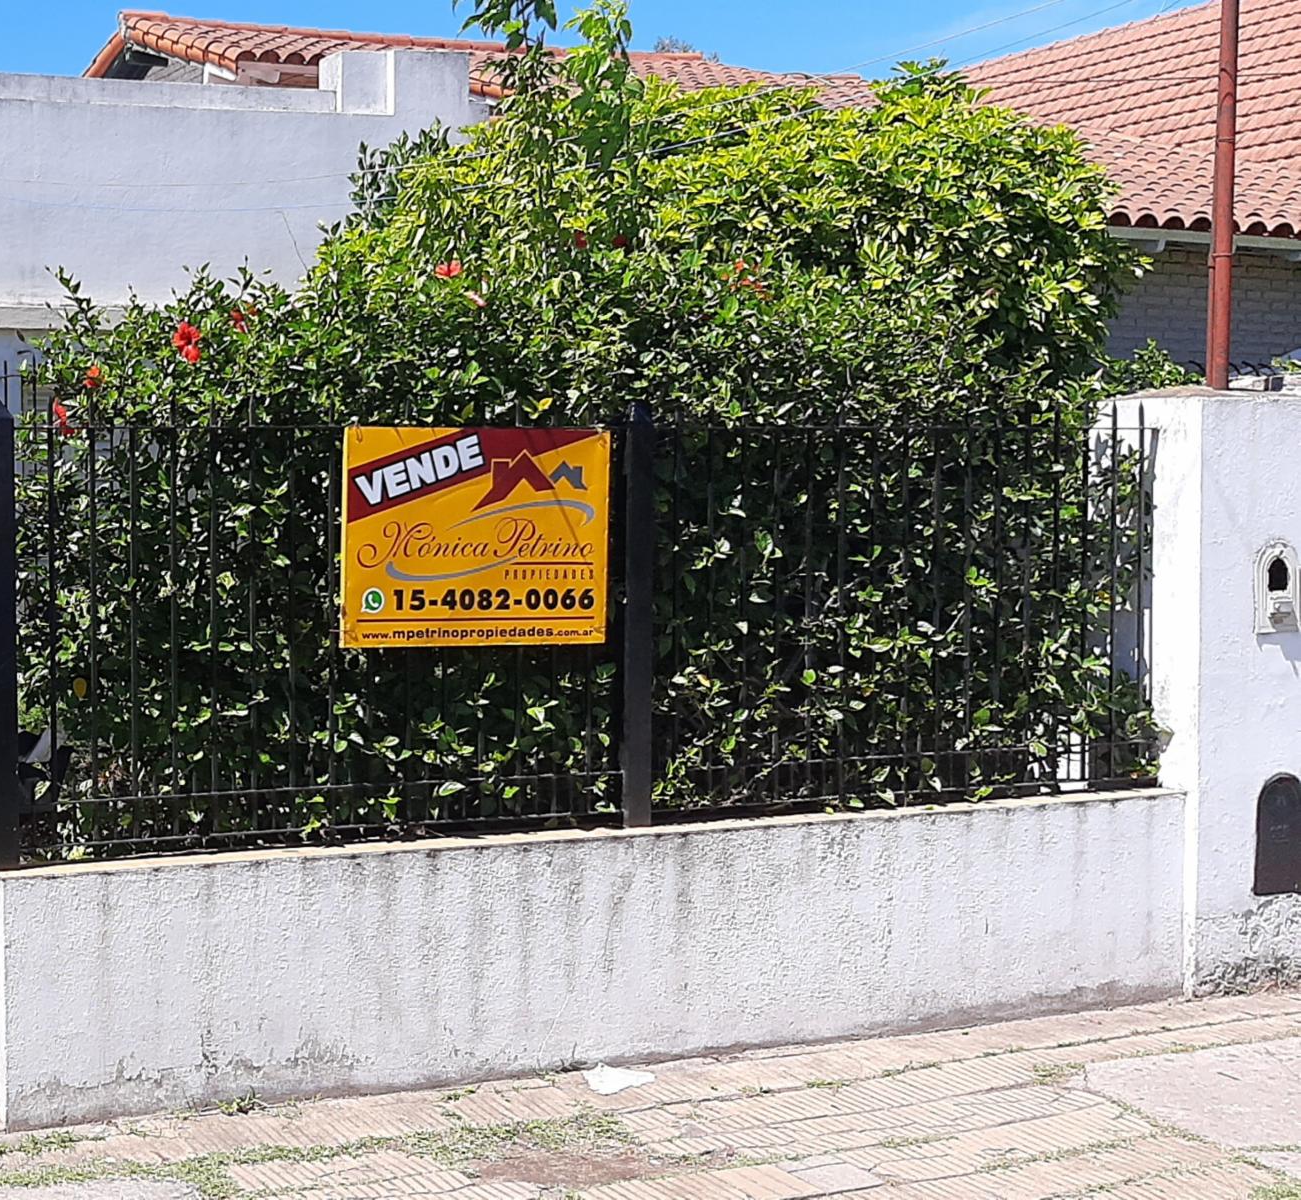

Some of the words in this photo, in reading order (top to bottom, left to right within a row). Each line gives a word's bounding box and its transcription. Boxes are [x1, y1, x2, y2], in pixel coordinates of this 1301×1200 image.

[354, 434, 485, 506] VENDE
[356, 521, 489, 569] Mónica
[493, 516, 595, 559] Petrino
[504, 569, 594, 580] PROPIEDADES
[393, 588, 595, 611] 15-4082-0066
[361, 626, 594, 640] www.mpetrinopropiedades.com.ar
